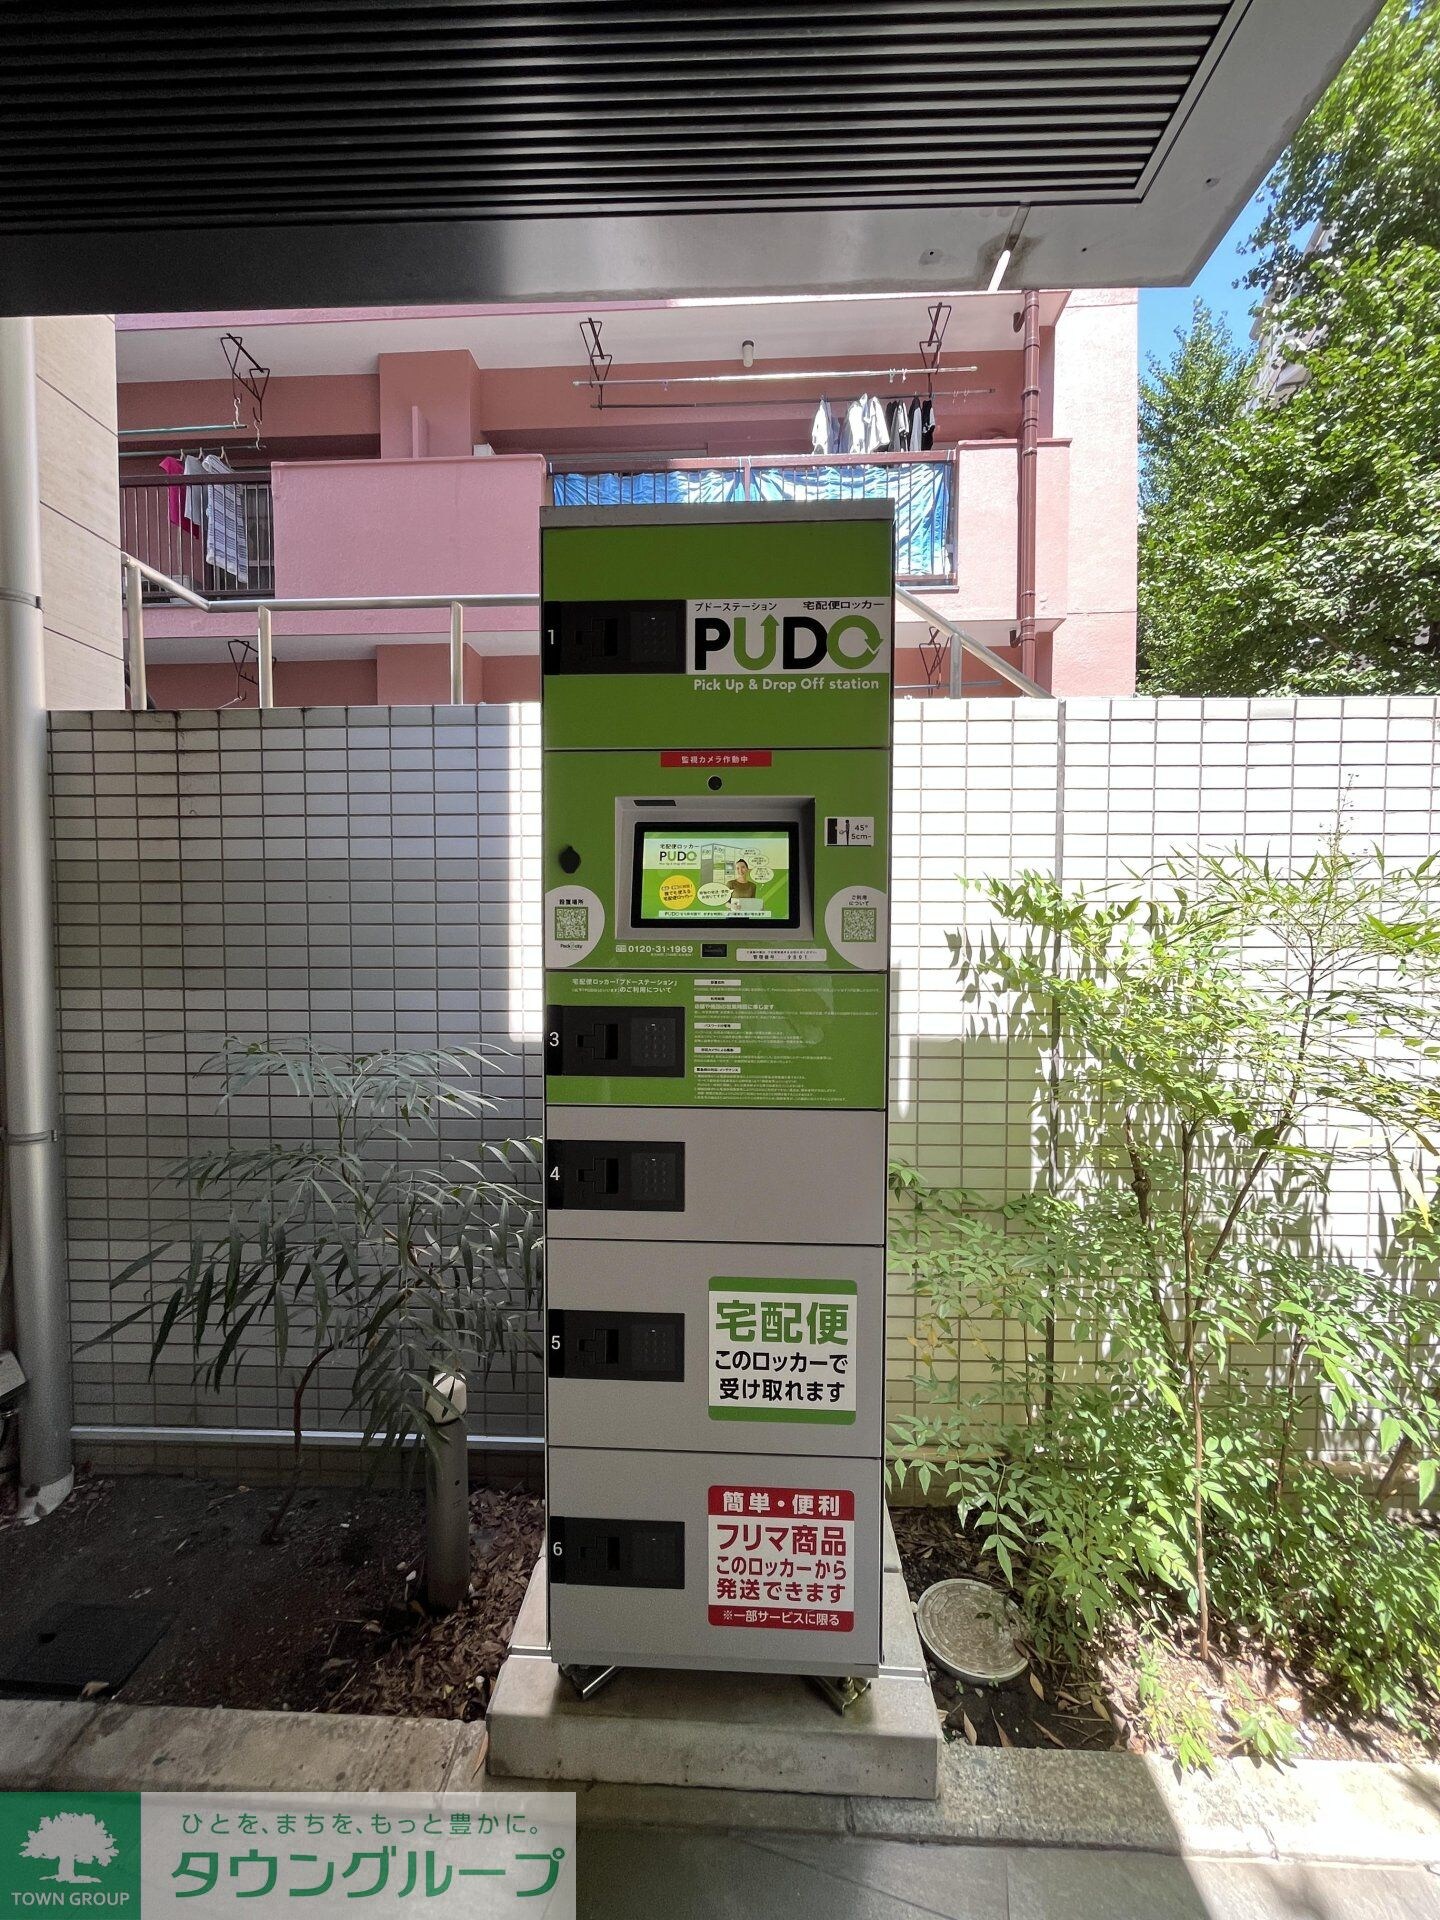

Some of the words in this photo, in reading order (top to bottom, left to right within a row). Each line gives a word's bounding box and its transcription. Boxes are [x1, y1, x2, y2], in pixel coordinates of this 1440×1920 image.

[803, 600, 885, 612] 宅配便ロッカー
[548, 629, 555, 645] 1
[694, 614, 884, 671] PUDO
[694, 678, 720, 691] Pick
[725, 678, 744, 694] Up
[748, 678, 758, 691] &
[762, 678, 797, 693] Drop
[801, 677, 825, 690] Off
[829, 678, 880, 690] station
[681, 755, 749, 764] 監視カメラ作動中
[659, 850, 698, 862] PUDO
[549, 1032, 560, 1047] 3
[549, 1166, 561, 1181] 4
[715, 1299, 849, 1346] 宅配便
[551, 1335, 561, 1350] 5
[715, 1350, 849, 1374] このロッカーで
[719, 1378, 846, 1402] 受け取れます
[722, 1491, 841, 1517] 簡単・便利
[716, 1522, 847, 1557] フリマ商品
[552, 1541, 563, 1556] 6
[716, 1555, 847, 1580] このロッカーから
[716, 1578, 846, 1604] 発送できます
